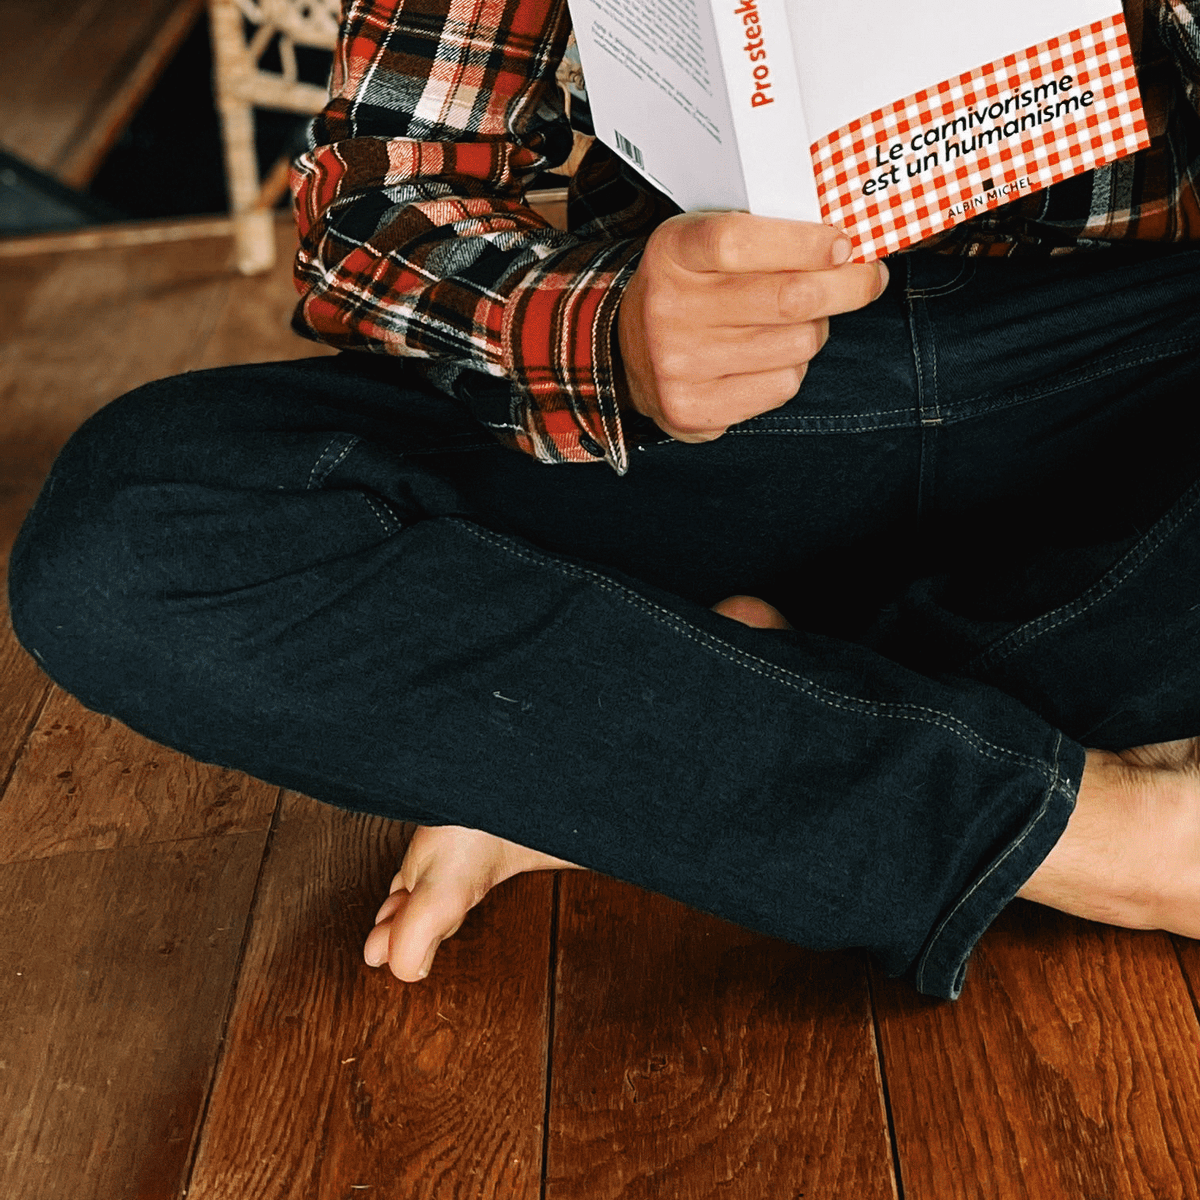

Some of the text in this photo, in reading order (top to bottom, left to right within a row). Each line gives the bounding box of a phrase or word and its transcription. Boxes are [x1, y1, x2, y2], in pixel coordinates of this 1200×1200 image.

[751, 64, 774, 107] Pro
[862, 90, 1094, 196] est un humanisme
[876, 74, 1073, 168] Le carnivorisme
[947, 176, 1034, 218] ALBIN MICHEL
